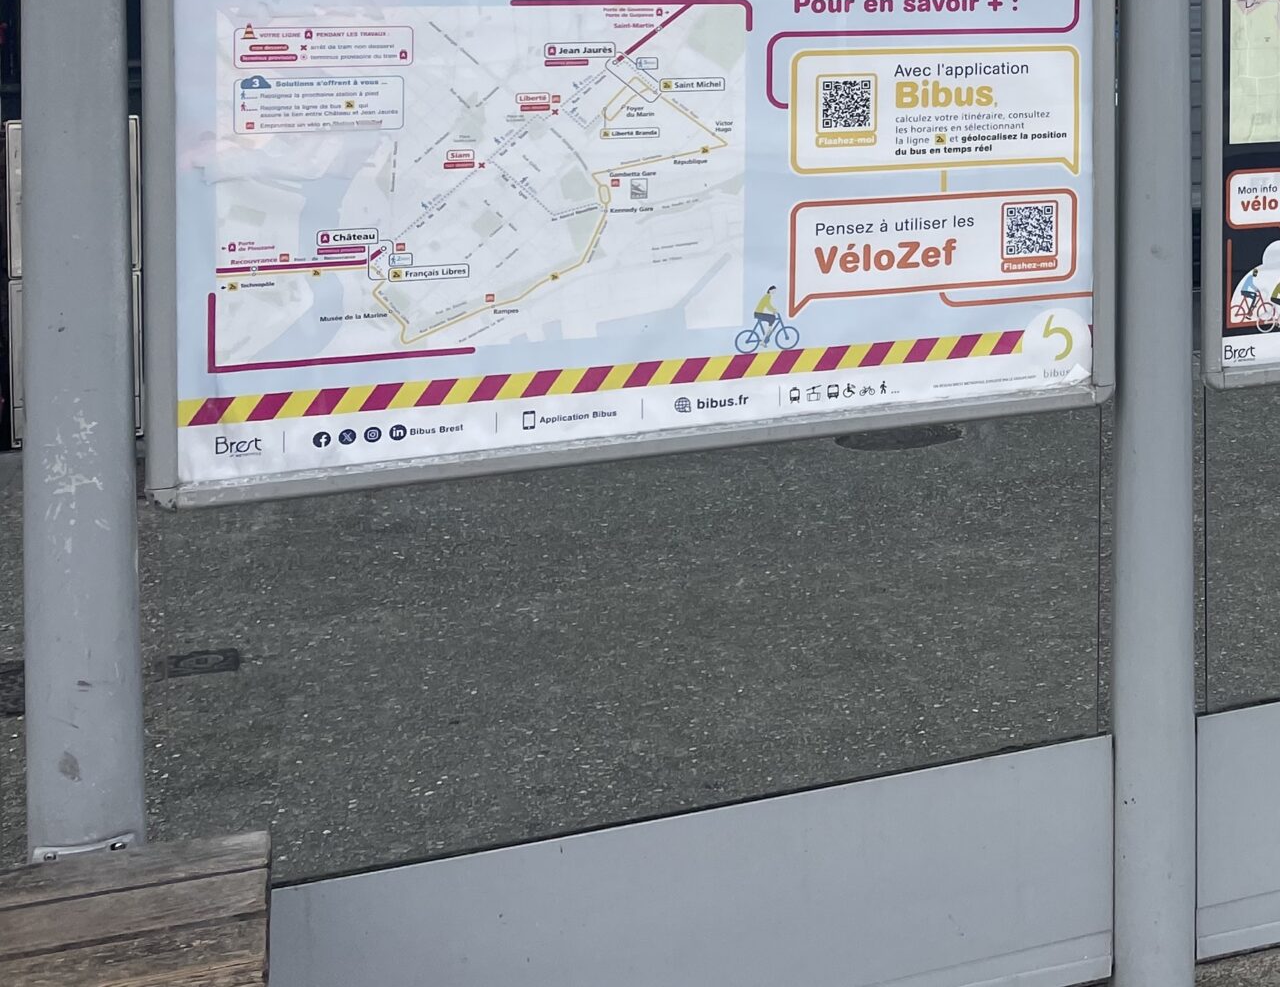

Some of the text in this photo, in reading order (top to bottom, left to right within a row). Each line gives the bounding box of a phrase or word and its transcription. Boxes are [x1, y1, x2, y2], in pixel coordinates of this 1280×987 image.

[559, 46, 580, 54] Jean
[894, 62, 1029, 77] Avec l'application
[696, 80, 721, 88] Michel
[961, 133, 1017, 143] géolocalisez
[1031, 131, 1067, 140] position
[909, 147, 927, 155] bus
[944, 145, 972, 156] temps
[975, 144, 992, 152] réel
[1238, 184, 1278, 194] Mon info
[1241, 195, 1278, 211] vélo
[816, 216, 974, 236] Pensez à utiliser les
[333, 233, 375, 241] Château
[814, 239, 956, 274] VéloZef
[1003, 260, 1056, 271] Flashez-moi
[405, 268, 466, 278] Français Libres
[697, 395, 749, 410] bibus.fr
[539, 410, 617, 424] Application Bibus
[410, 424, 463, 435] Bibus Brest
[215, 436, 261, 454] Brest
